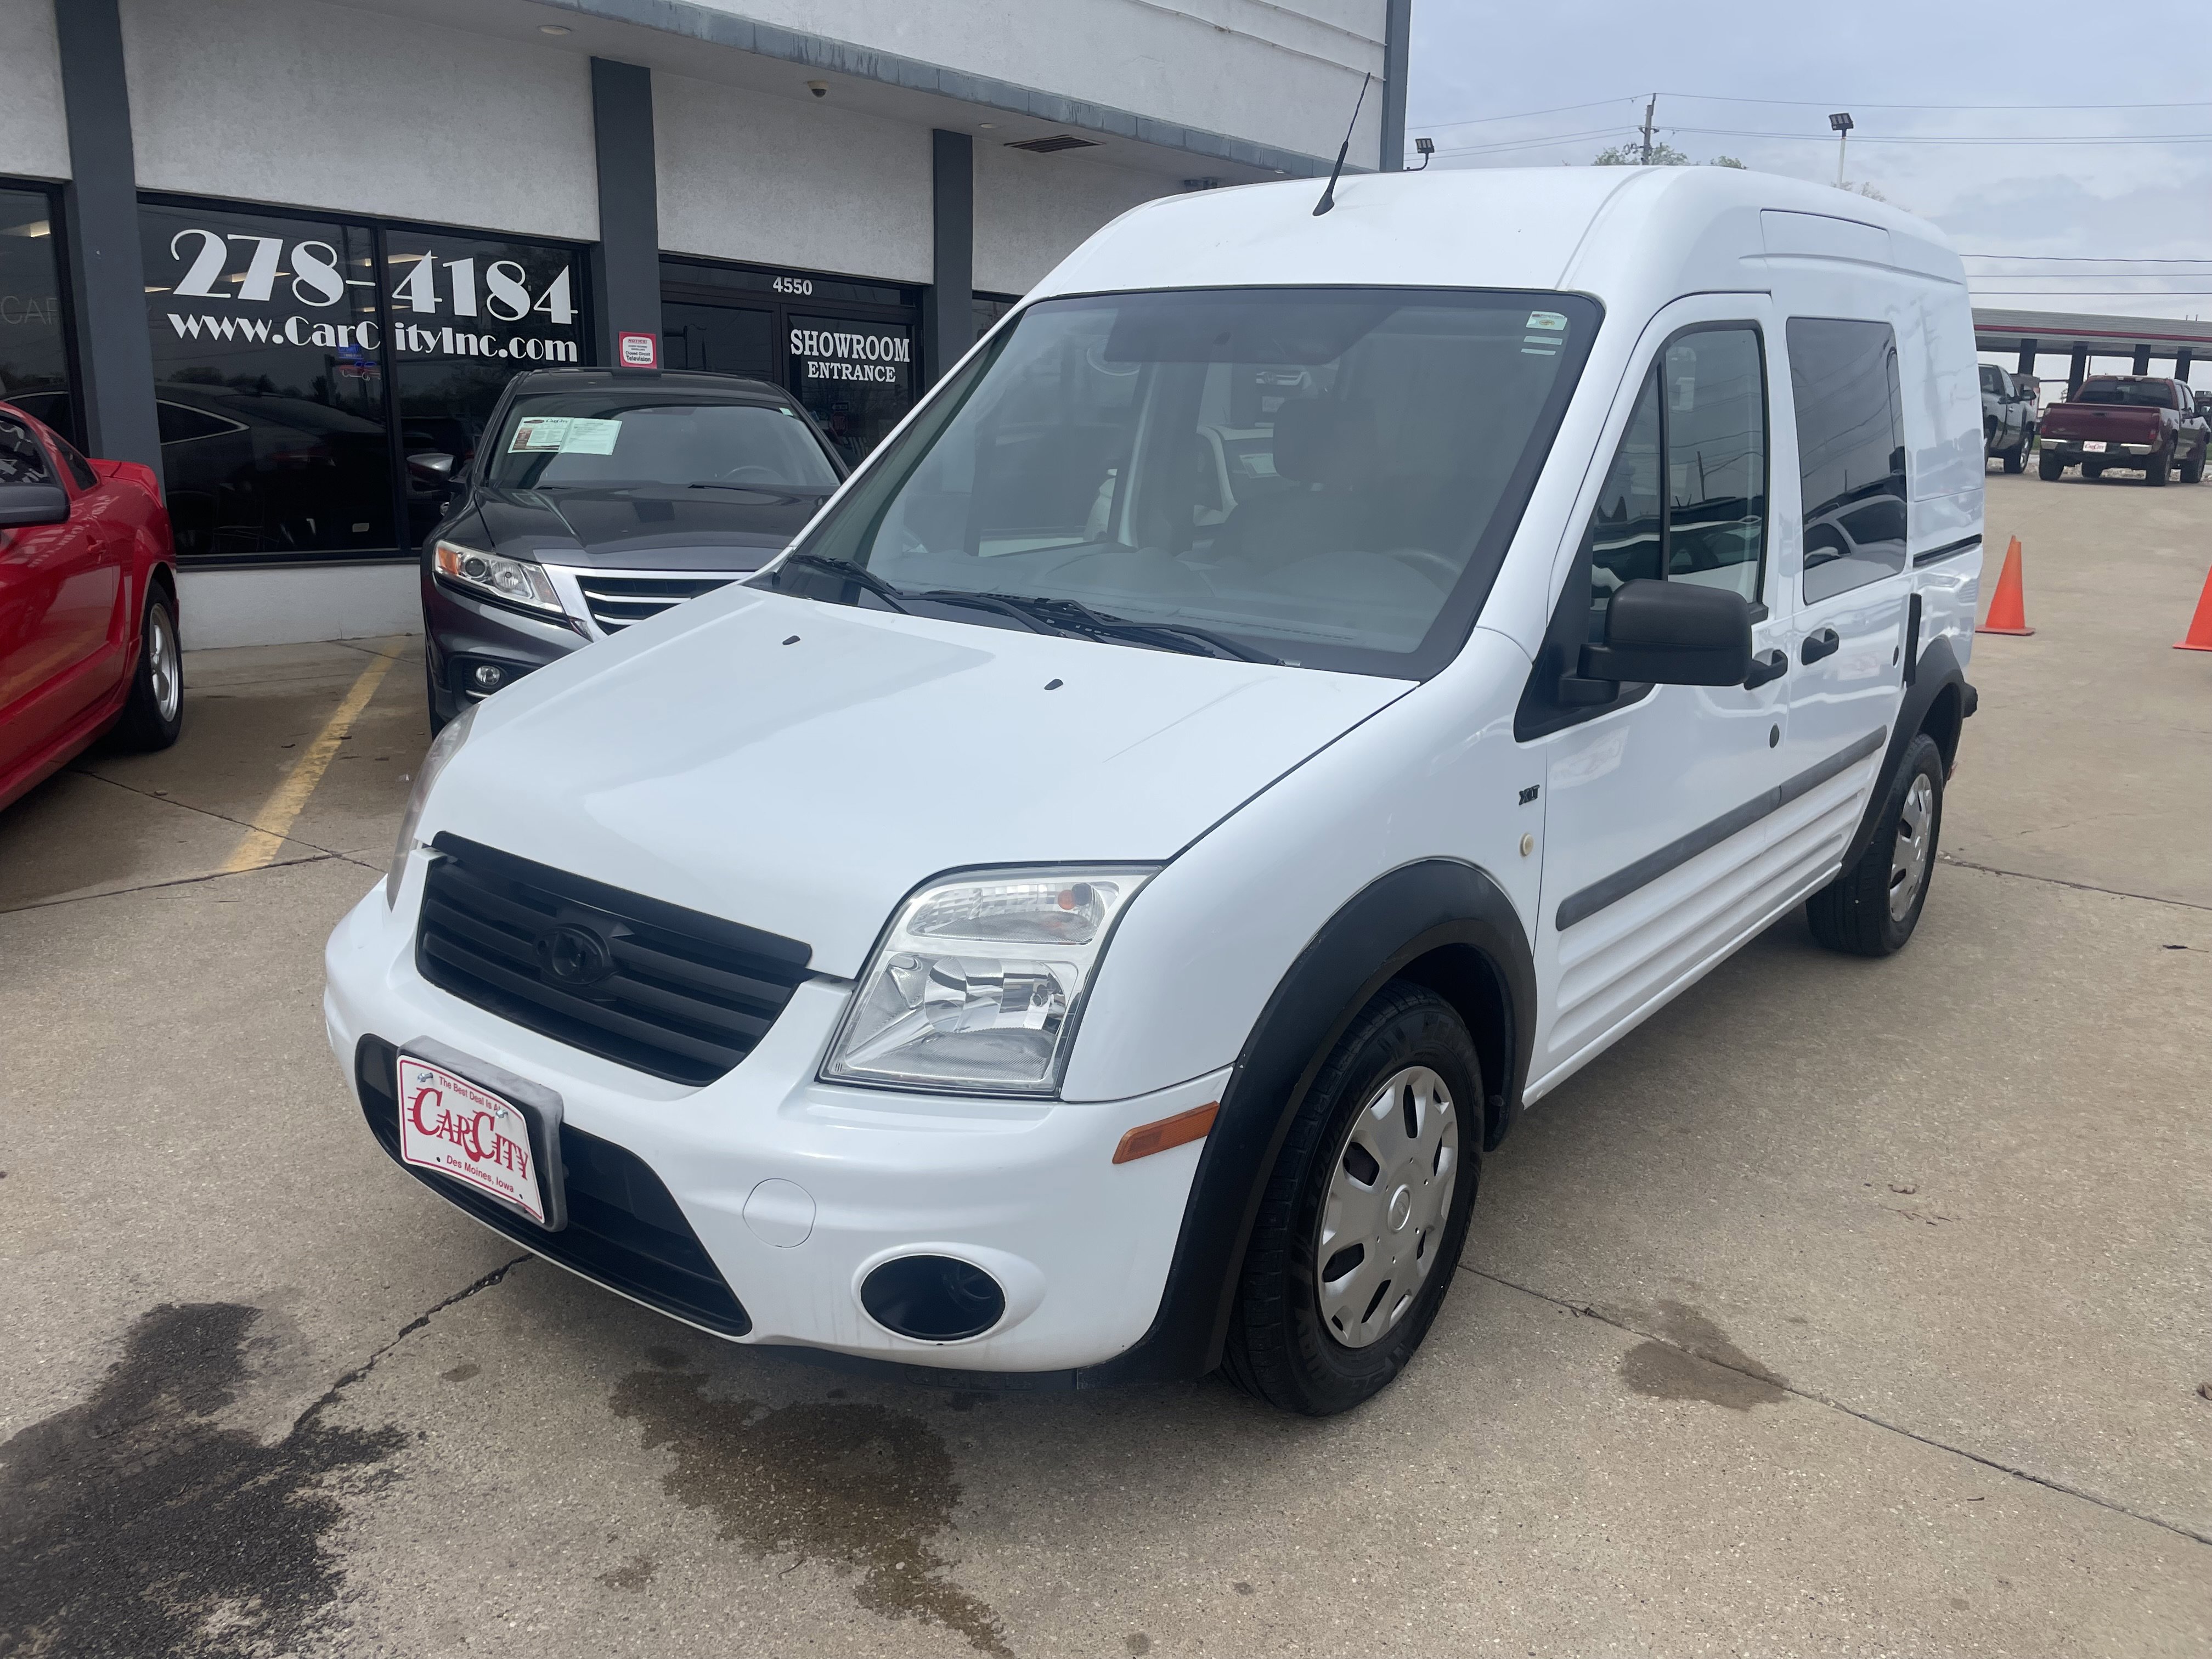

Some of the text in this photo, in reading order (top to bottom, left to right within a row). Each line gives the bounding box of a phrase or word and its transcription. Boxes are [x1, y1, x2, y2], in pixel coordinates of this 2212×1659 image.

[170, 229, 579, 325] 278-4184
[772, 276, 813, 296] 4550
[790, 329, 910, 363] SHOWROOM
[807, 361, 896, 382] ENTRANCE
[1519, 784, 1540, 805] XLT
[439, 1076, 452, 1089] The
[453, 1083, 468, 1098] Best
[470, 1091, 484, 1105] Deal
[486, 1099, 492, 1109] Is
[447, 1155, 515, 1193] Des Moines, Iowa
